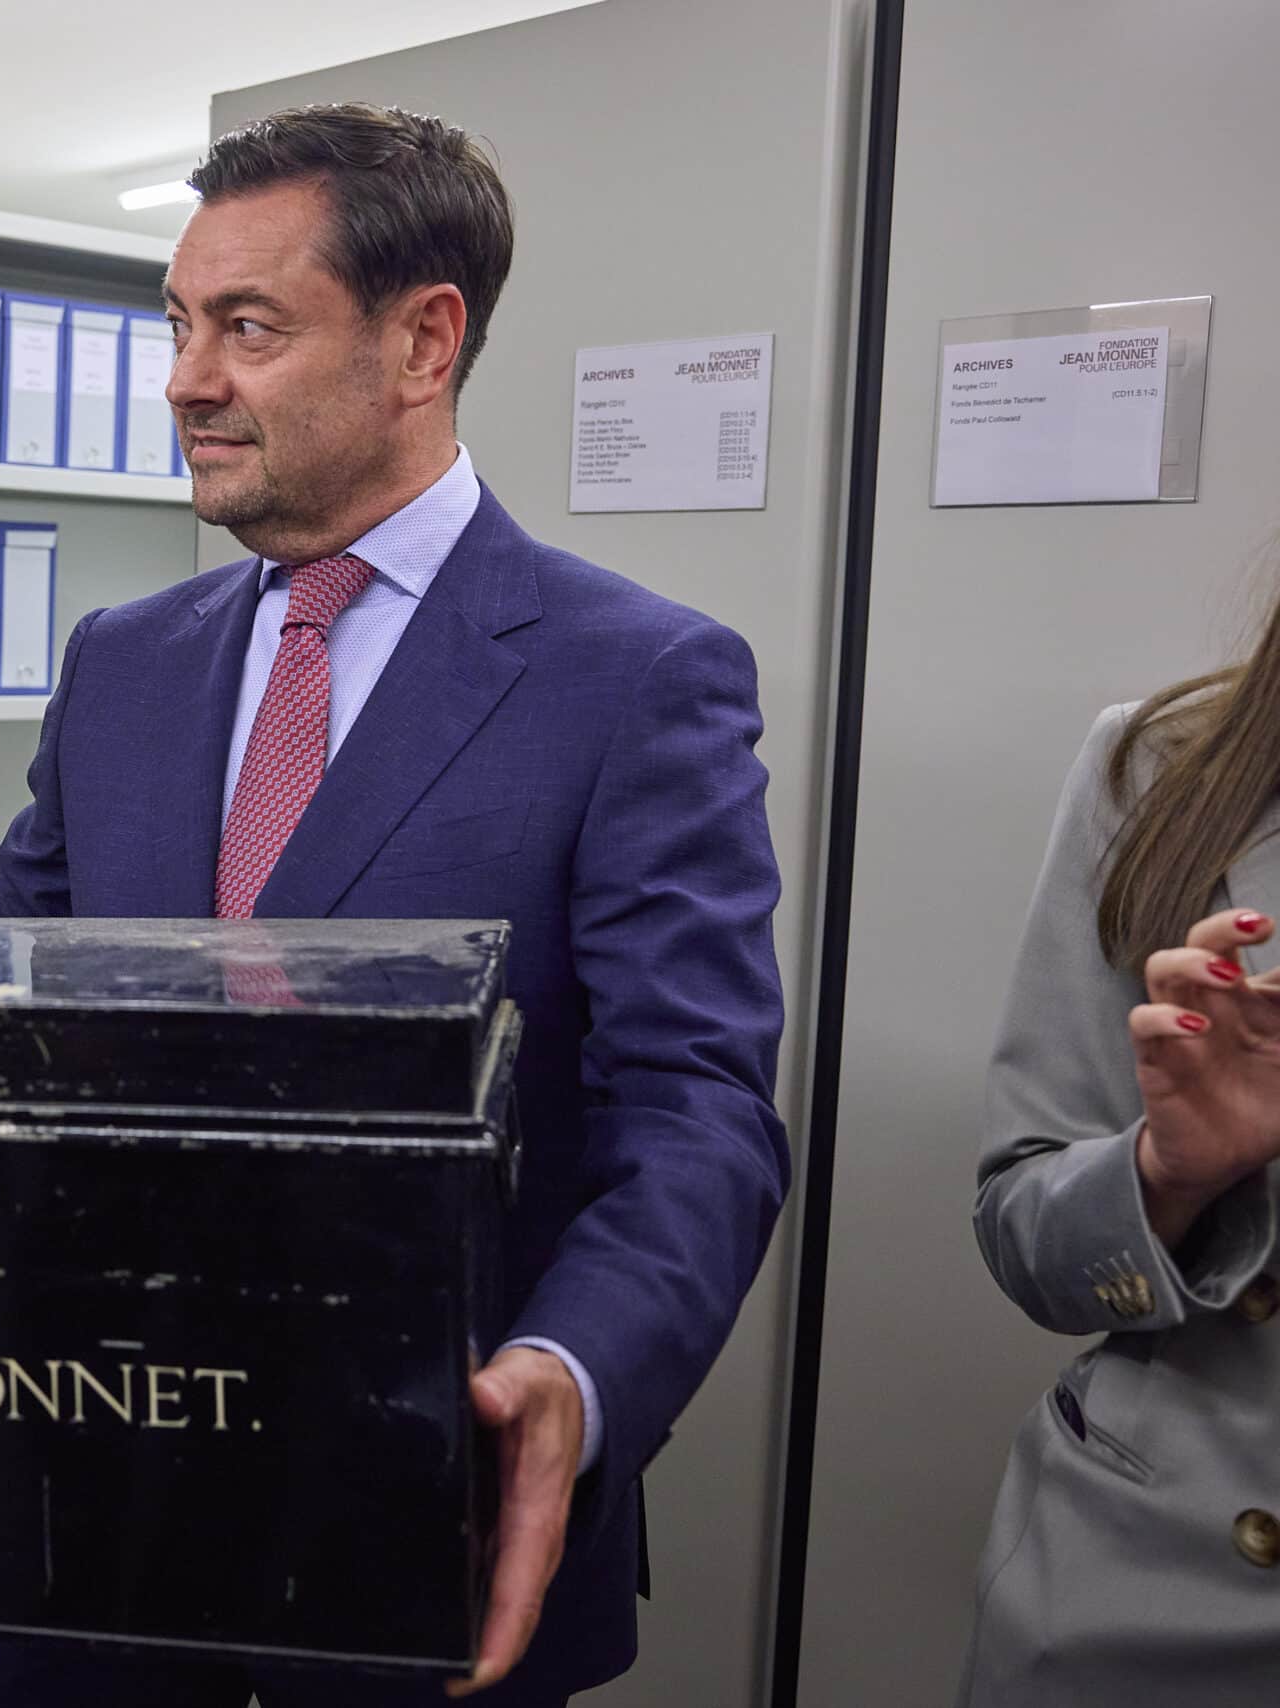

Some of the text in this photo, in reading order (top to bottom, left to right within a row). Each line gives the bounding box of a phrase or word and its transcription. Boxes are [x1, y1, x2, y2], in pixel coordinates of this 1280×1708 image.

[1099, 337, 1159, 350] FONDATION
[709, 348, 761, 360] FONDATION
[1059, 347, 1157, 365] JEAN MONNET
[674, 358, 760, 376] JEAN MONNET
[953, 358, 1013, 373] ARCHIVES
[1079, 364, 1107, 374] POUR
[582, 368, 634, 383] ARCHIVES
[691, 374, 716, 384] POUR
[979, 381, 997, 390] CD11
[972, 416, 986, 424] Paul
